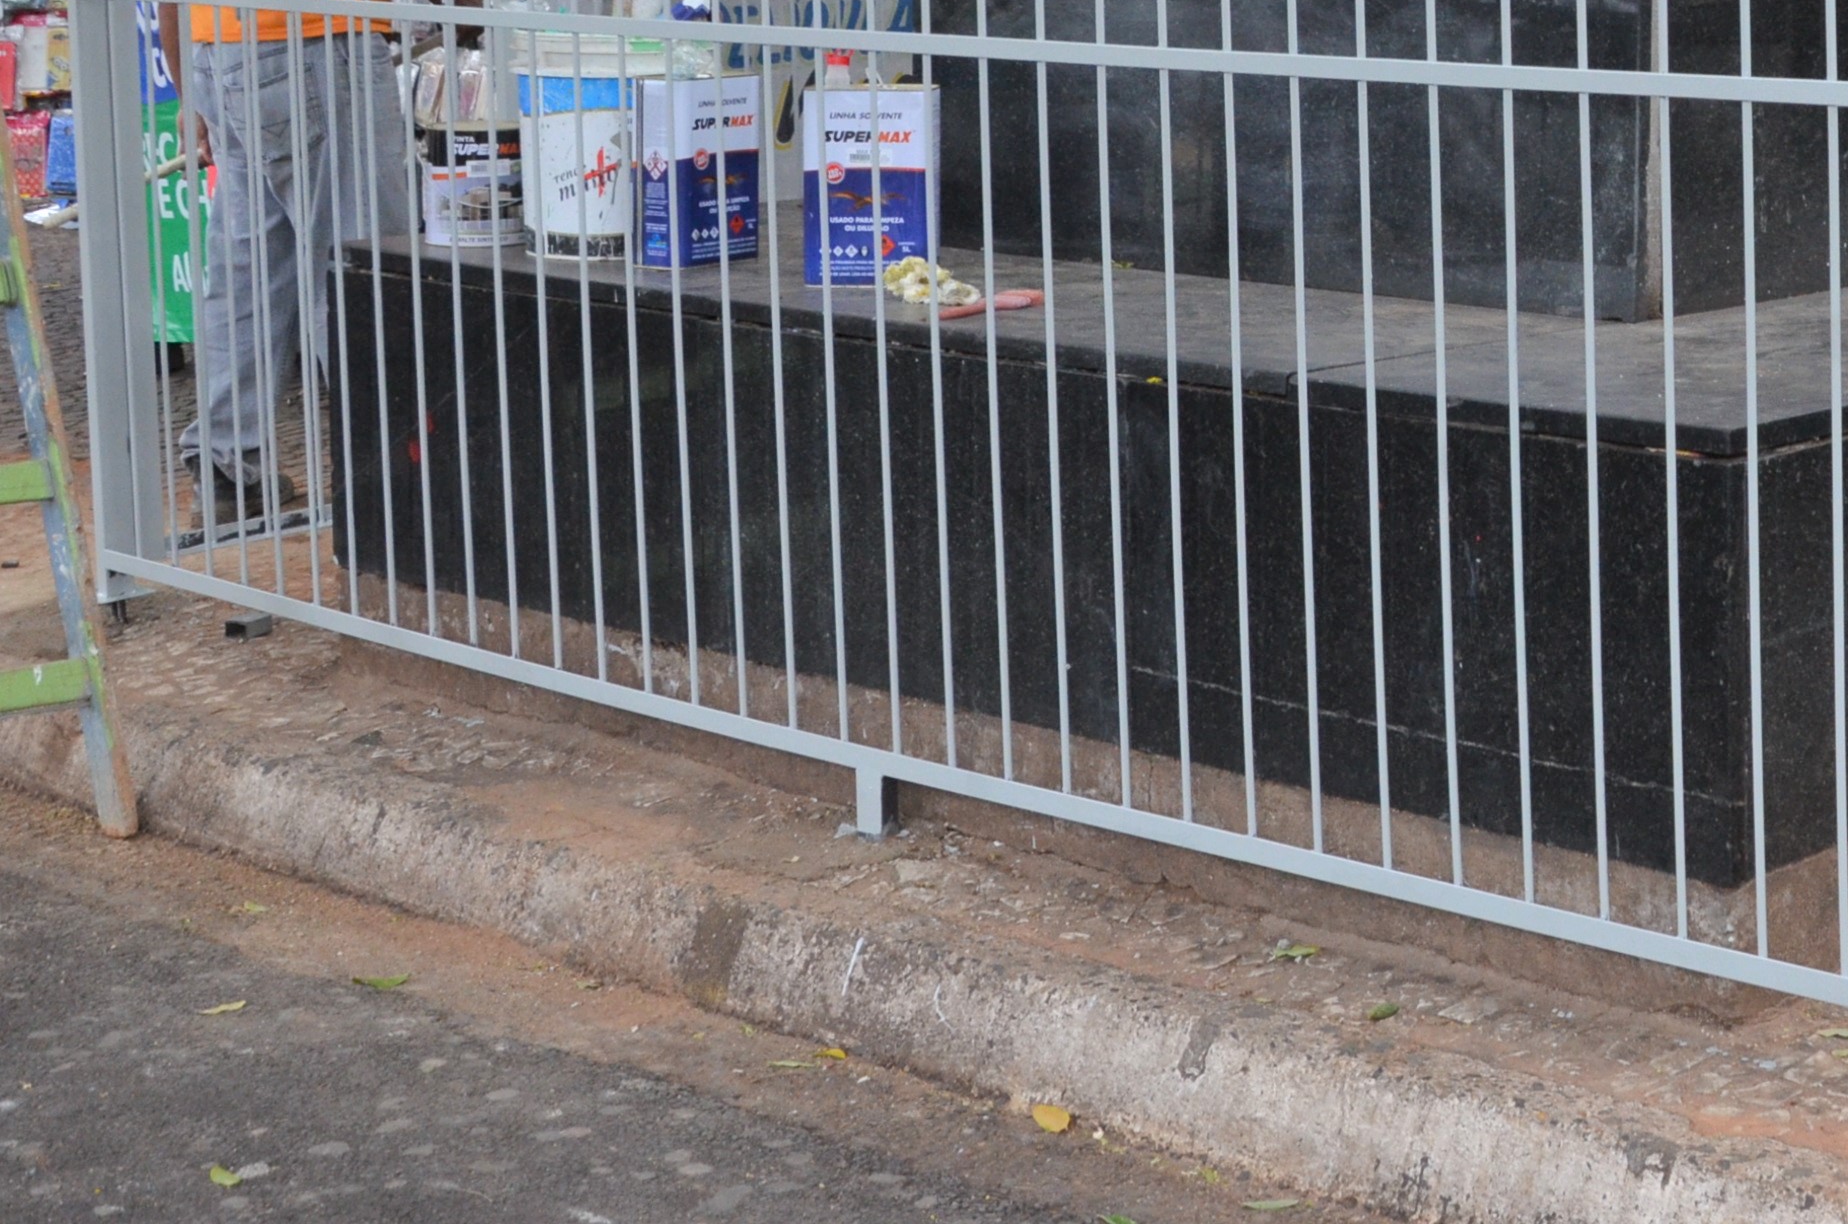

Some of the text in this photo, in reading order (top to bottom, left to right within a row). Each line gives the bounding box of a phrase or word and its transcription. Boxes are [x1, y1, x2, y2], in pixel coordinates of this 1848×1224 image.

[859, 112, 903, 120] SOVENTE
[692, 114, 754, 131] SUPRMAX
[829, 216, 855, 224] USADO
